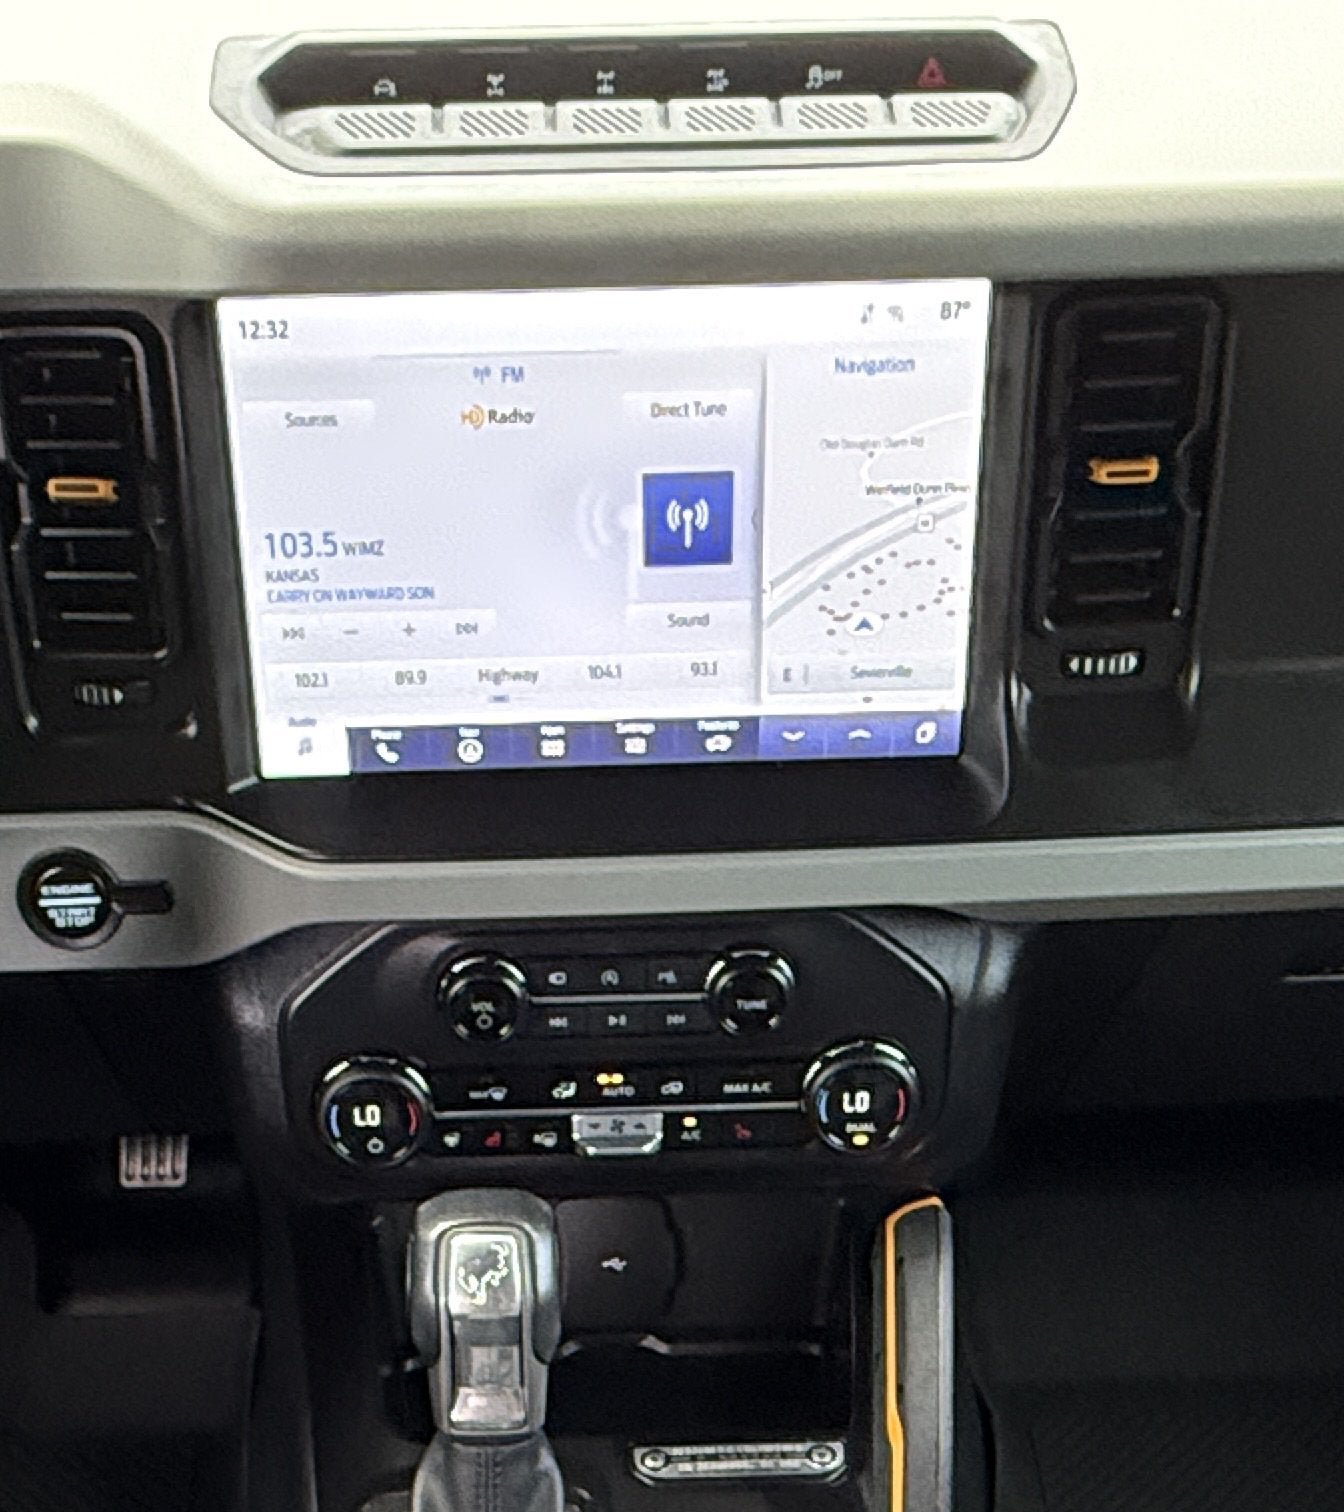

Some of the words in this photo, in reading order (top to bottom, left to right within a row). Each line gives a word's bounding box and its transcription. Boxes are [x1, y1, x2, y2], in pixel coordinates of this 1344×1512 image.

[239, 319, 290, 340] 12:32
[500, 366, 525, 383] FM
[834, 356, 916, 375] Navigation
[650, 402, 690, 418] Direct
[693, 400, 727, 417] Tune
[284, 411, 339, 428] Sources
[264, 531, 338, 559] 103.5
[265, 568, 320, 584] KANSAS
[267, 588, 311, 603] CARRY
[312, 587, 333, 602] ON
[336, 587, 404, 602] WAYWARD
[406, 586, 435, 600] SON
[667, 613, 710, 628] Sound
[394, 670, 427, 685] 89.9
[477, 667, 539, 685] Highway
[842, 1090, 871, 1113] LO
[352, 1104, 382, 1127] LO
